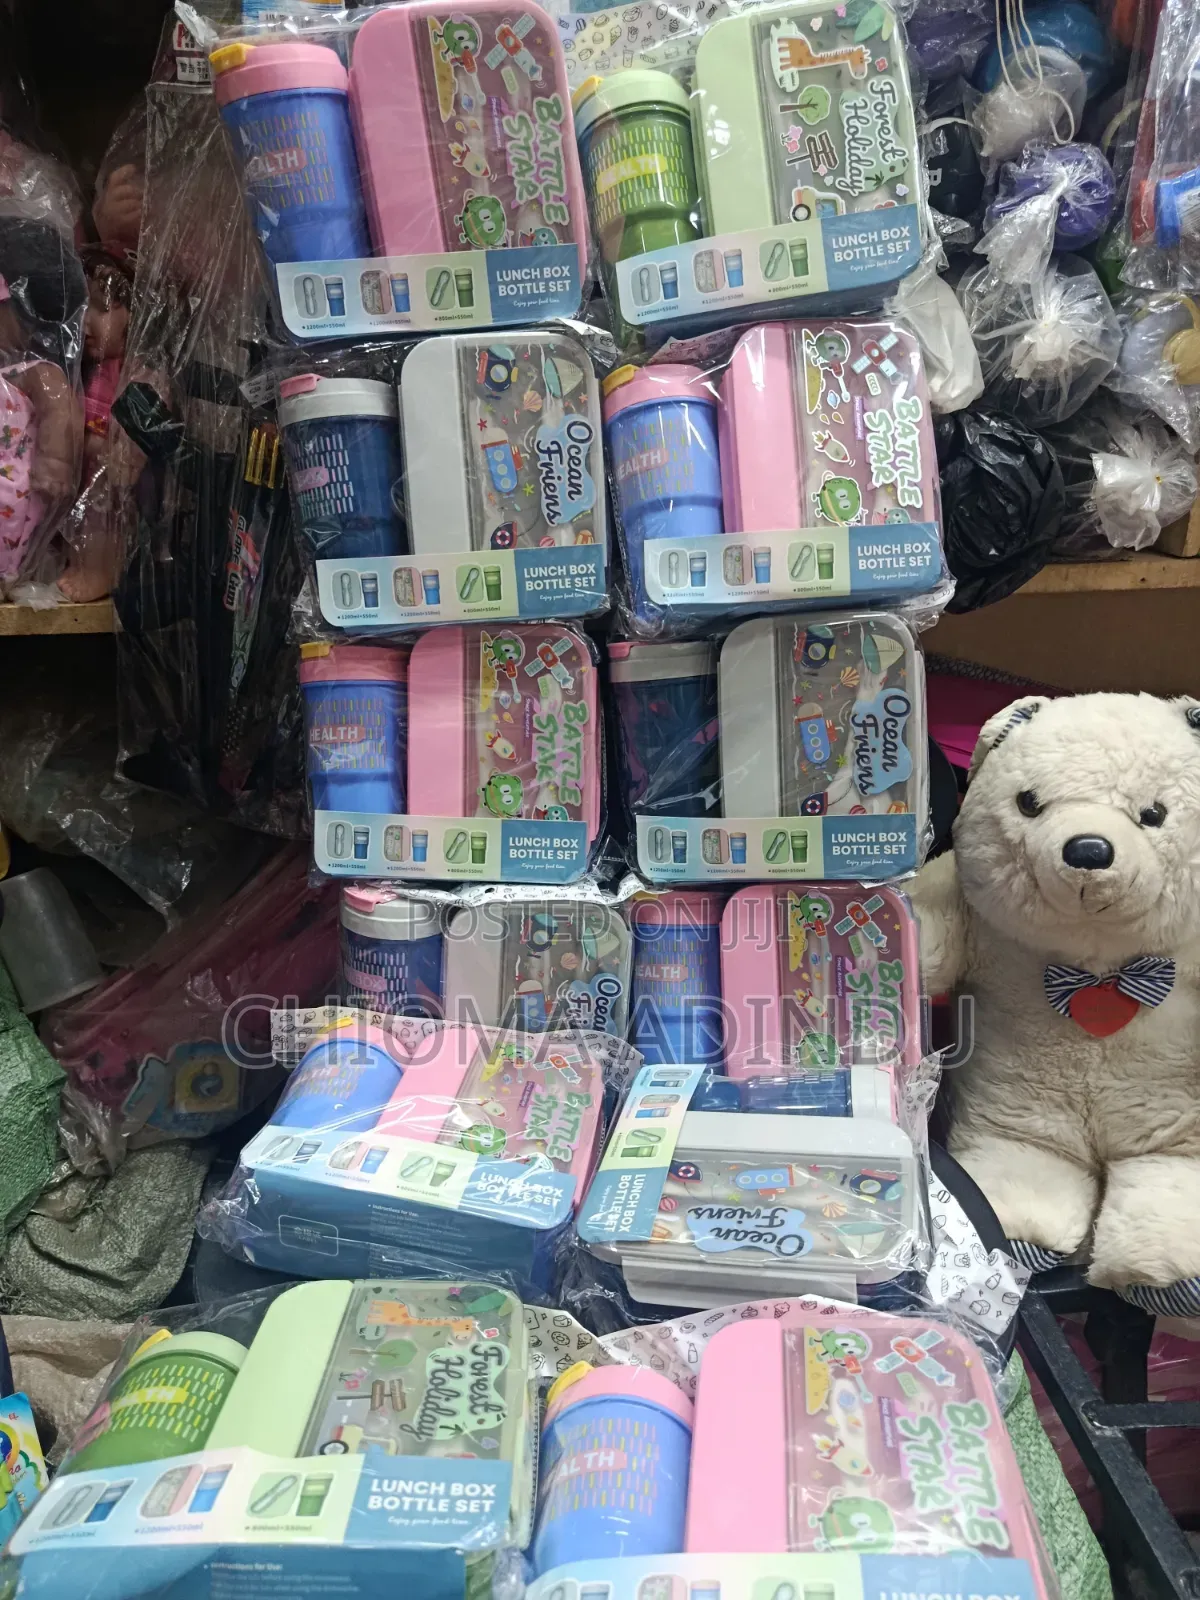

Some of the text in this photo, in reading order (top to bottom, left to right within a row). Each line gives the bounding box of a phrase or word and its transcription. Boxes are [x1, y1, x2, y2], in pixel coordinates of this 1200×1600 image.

[869, 80, 907, 162] Forest
[502, 110, 540, 205] STAR
[533, 93, 570, 226] BATTLE
[838, 98, 875, 196] Holiday
[832, 226, 910, 249] LUNCH BOX
[833, 240, 911, 262] BOTTLE SET
[496, 266, 571, 281] LUNCH BOX
[498, 280, 571, 296] BOTTLE SET
[566, 420, 593, 501] Ocean
[617, 450, 661, 480] EALTH
[863, 409, 897, 488] STAR
[893, 396, 922, 508] BATTLE
[536, 440, 564, 525] Friens
[857, 542, 931, 557] LUNCH BOX
[858, 555, 931, 570] BOTTLE SET
[524, 563, 596, 578] LUNCH BOX
[525, 576, 596, 591] BOTTLE SET
[310, 726, 359, 742] HEALTH
[533, 713, 559, 784] STAR
[560, 700, 589, 806] BATTLE
[884, 695, 911, 773] Ocean
[851, 713, 879, 795] Friens
[509, 837, 579, 848] LUNCH BOX
[509, 849, 579, 860] BOTTLE SET
[831, 832, 907, 843] LUNCH BOX
[832, 844, 907, 856] BOTTLE SET
[635, 965, 681, 979] EALTH
[524, 1093, 558, 1139] STAR
[546, 1091, 592, 1163] BATTLE
[608, 1175, 632, 1213] BOTTLE
[618, 1174, 647, 1232] LUNCH BOX
[687, 1207, 789, 1228] Friens
[710, 1227, 805, 1256] Ocean
[399, 1356, 465, 1441] Holiday
[469, 1344, 504, 1416] Forest
[895, 1416, 954, 1513] STAR
[943, 1399, 1010, 1549] BATTLE
[367, 1495, 495, 1513] BOTTLE SET
[370, 1479, 496, 1497] LUNCH BOX
